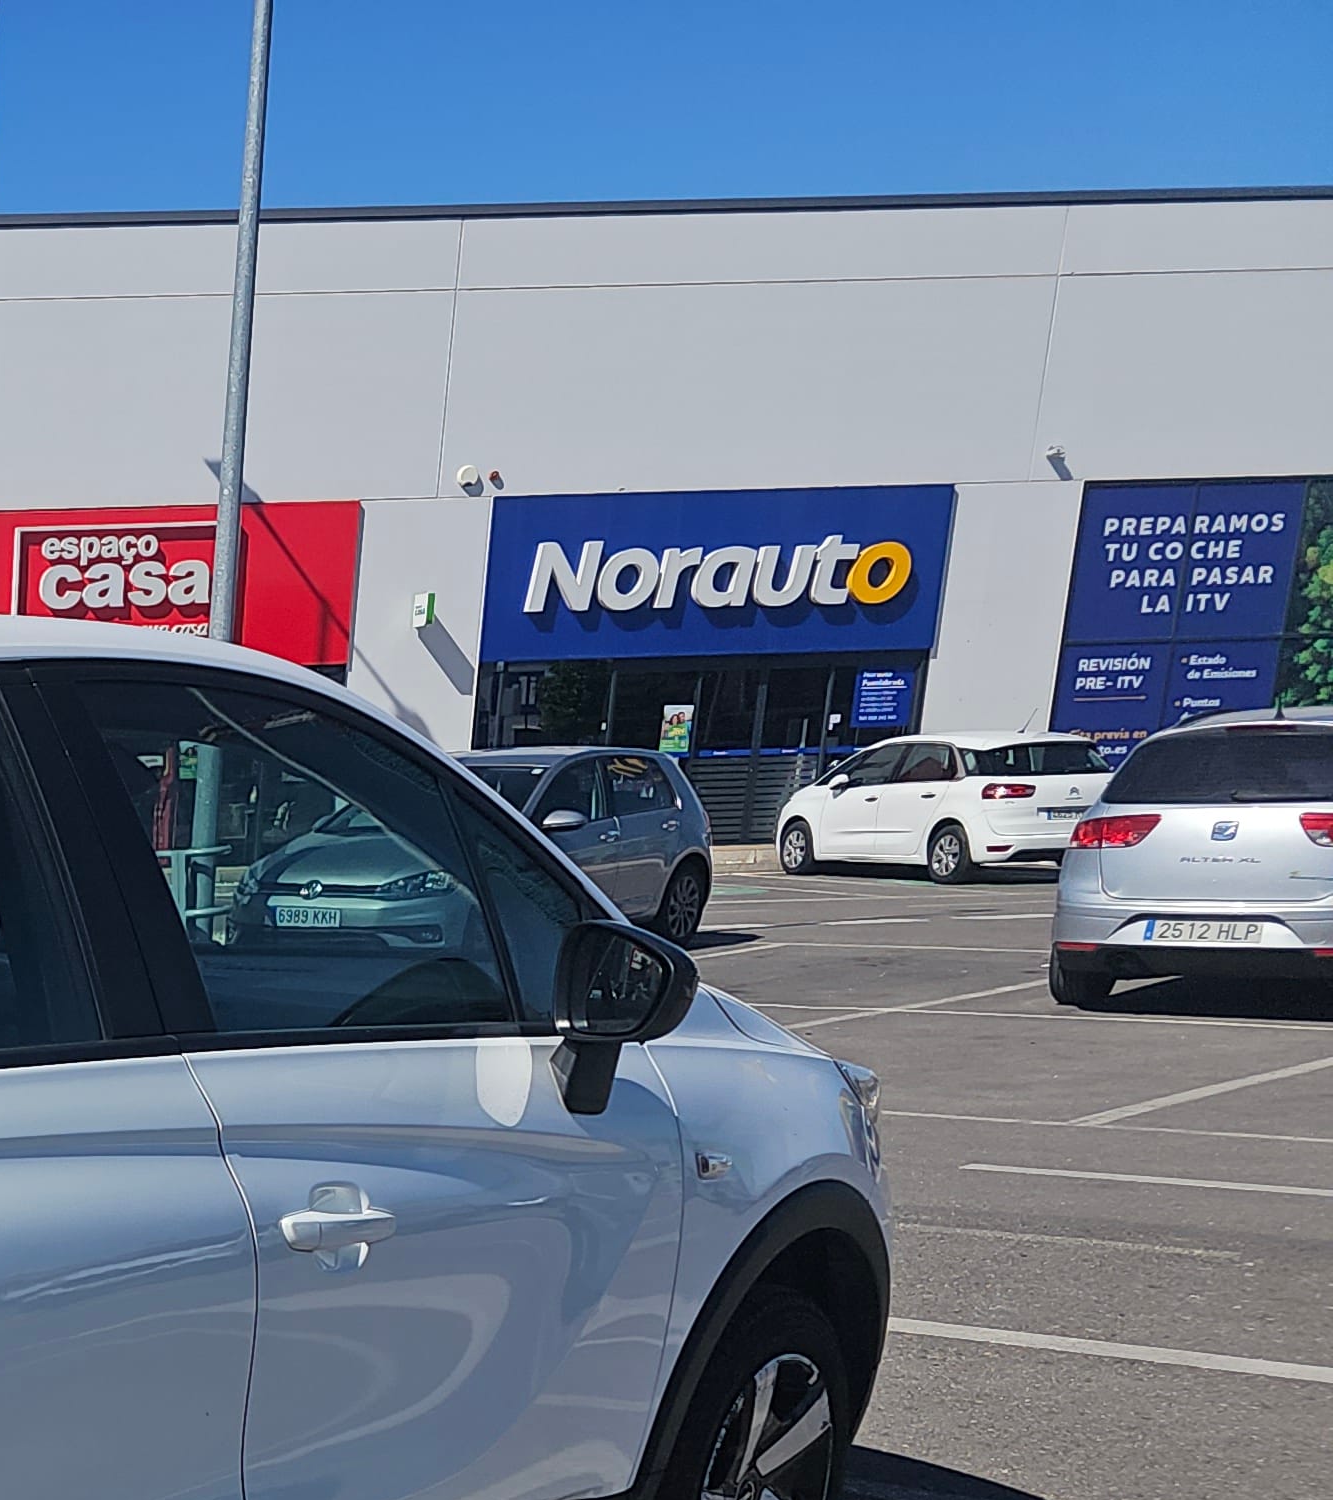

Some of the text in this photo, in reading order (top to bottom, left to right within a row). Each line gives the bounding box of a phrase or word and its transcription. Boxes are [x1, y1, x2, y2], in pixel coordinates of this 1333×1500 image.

[1103, 513, 1286, 536] PREPARAMOS
[42, 535, 158, 566] espaço
[1105, 540, 1242, 561] TU COCHE
[524, 534, 912, 613] Norauto
[1109, 566, 1273, 588] PARA PASAR
[39, 559, 210, 610] casa
[1141, 593, 1231, 613] LA ITV
[1078, 653, 1151, 672] REVISIÓN
[1117, 675, 1144, 689] ITV
[278, 909, 337, 925] 6989 KKH
[1157, 923, 1258, 940] 2512 HLP
